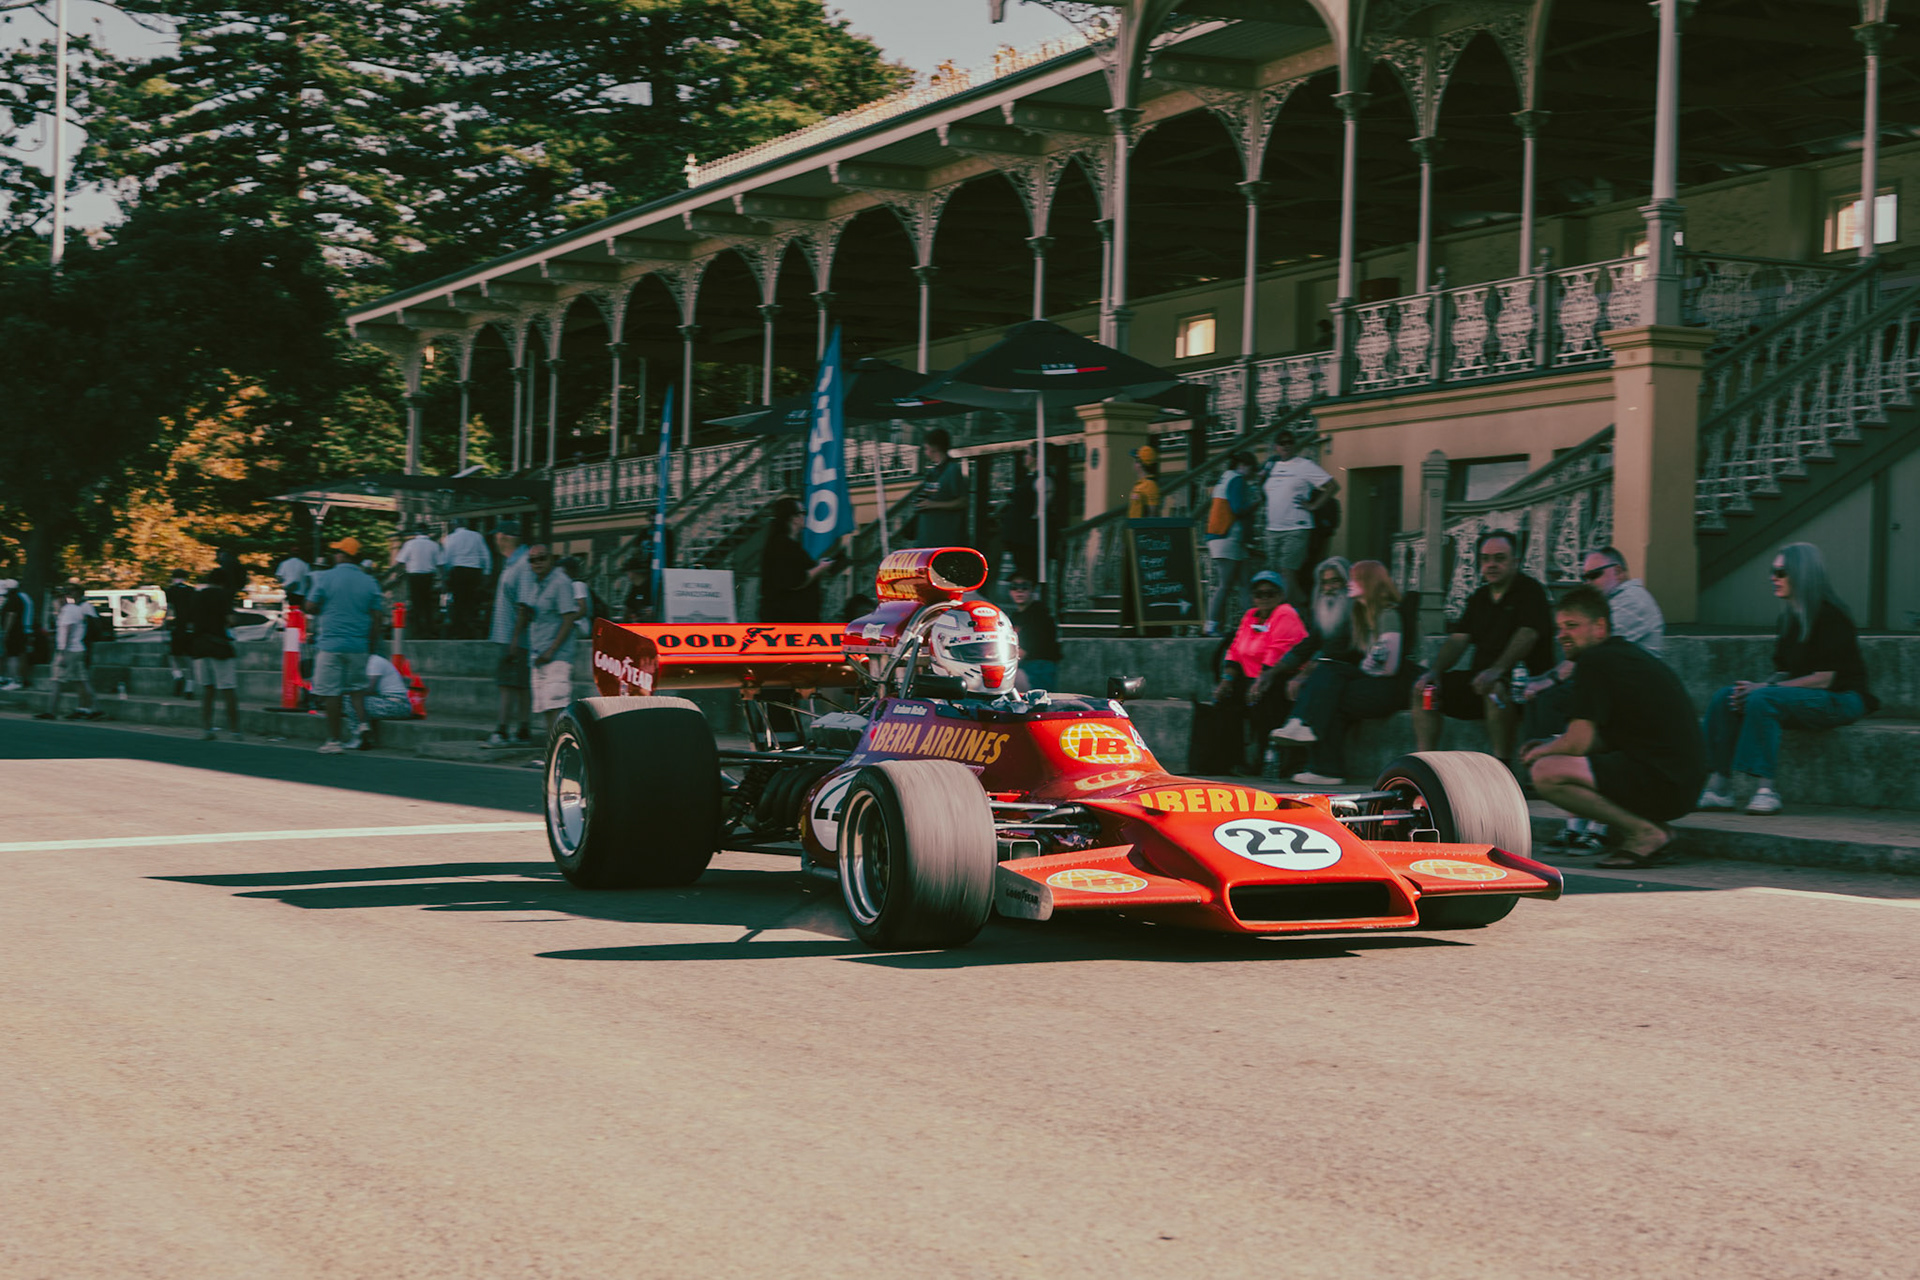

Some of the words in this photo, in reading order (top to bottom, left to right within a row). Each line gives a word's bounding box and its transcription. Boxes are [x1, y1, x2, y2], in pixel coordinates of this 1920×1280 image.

[657, 633, 736, 648] OOD
[868, 722, 922, 754] IBERIA
[918, 725, 1010, 765] AIRLINES
[1078, 737, 1130, 757] IB
[1139, 788, 1278, 812] IBERIA
[1224, 826, 1329, 855] 22
